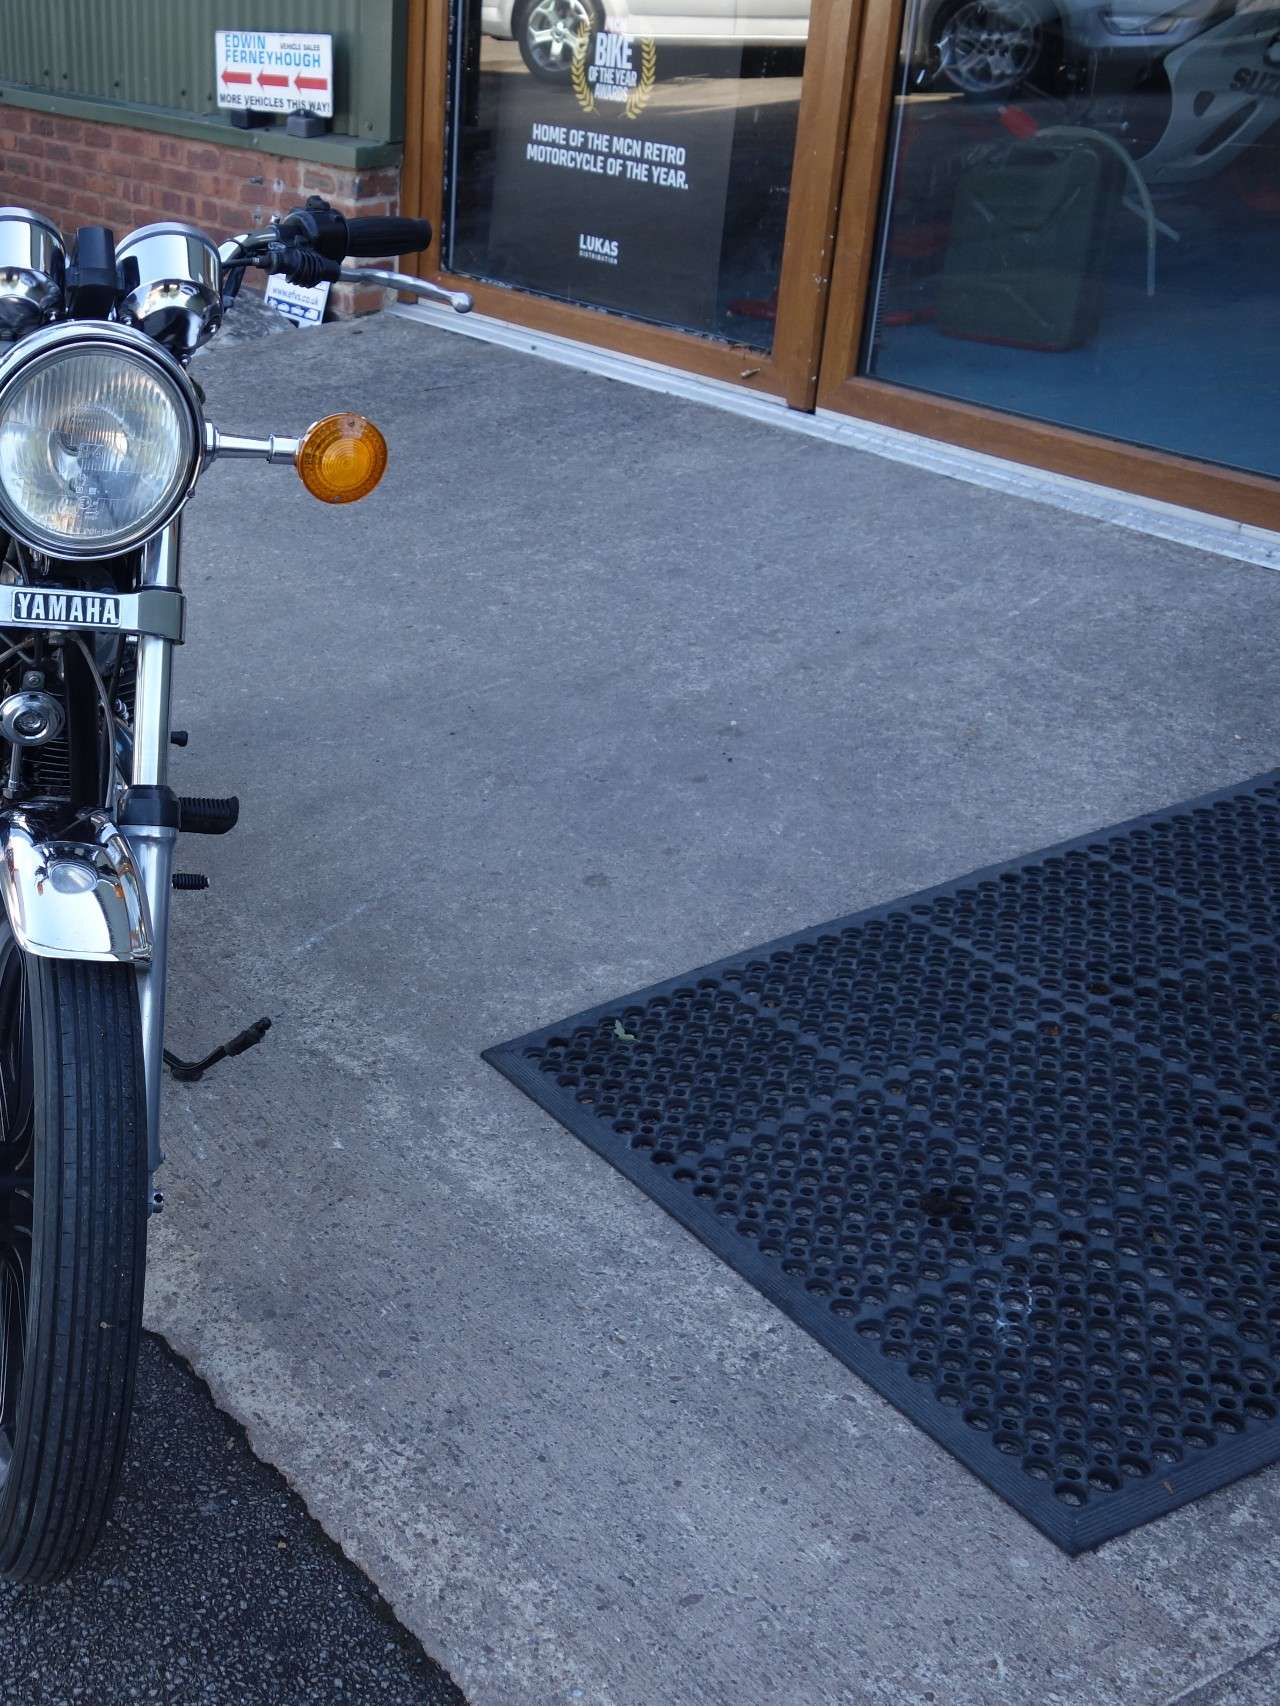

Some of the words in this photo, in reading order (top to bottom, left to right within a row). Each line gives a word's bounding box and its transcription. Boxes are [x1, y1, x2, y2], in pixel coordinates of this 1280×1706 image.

[224, 34, 266, 49] EDWIN
[595, 32, 635, 69] BIKE
[225, 49, 321, 68] FERNEYHOUGH
[588, 66, 598, 82] OF
[599, 68, 614, 84] THE
[615, 69, 637, 87] YEAR
[594, 82, 628, 102] AWARDS
[219, 94, 242, 105] MORE
[244, 96, 284, 108] VEHICLES
[287, 99, 306, 111] THIS
[309, 101, 330, 113] WAY!
[532, 122, 567, 145] HOME
[569, 128, 586, 148] OF
[587, 132, 610, 153] THE
[612, 136, 642, 159] MCN
[644, 141, 686, 166] RETRO
[526, 143, 605, 174] MOTORCYCLE
[606, 157, 623, 177] OF
[626, 160, 649, 182] THE
[651, 166, 689, 190] YEAR.
[580, 233, 619, 257] LUKAS
[18, 593, 117, 624] YAMAHA
